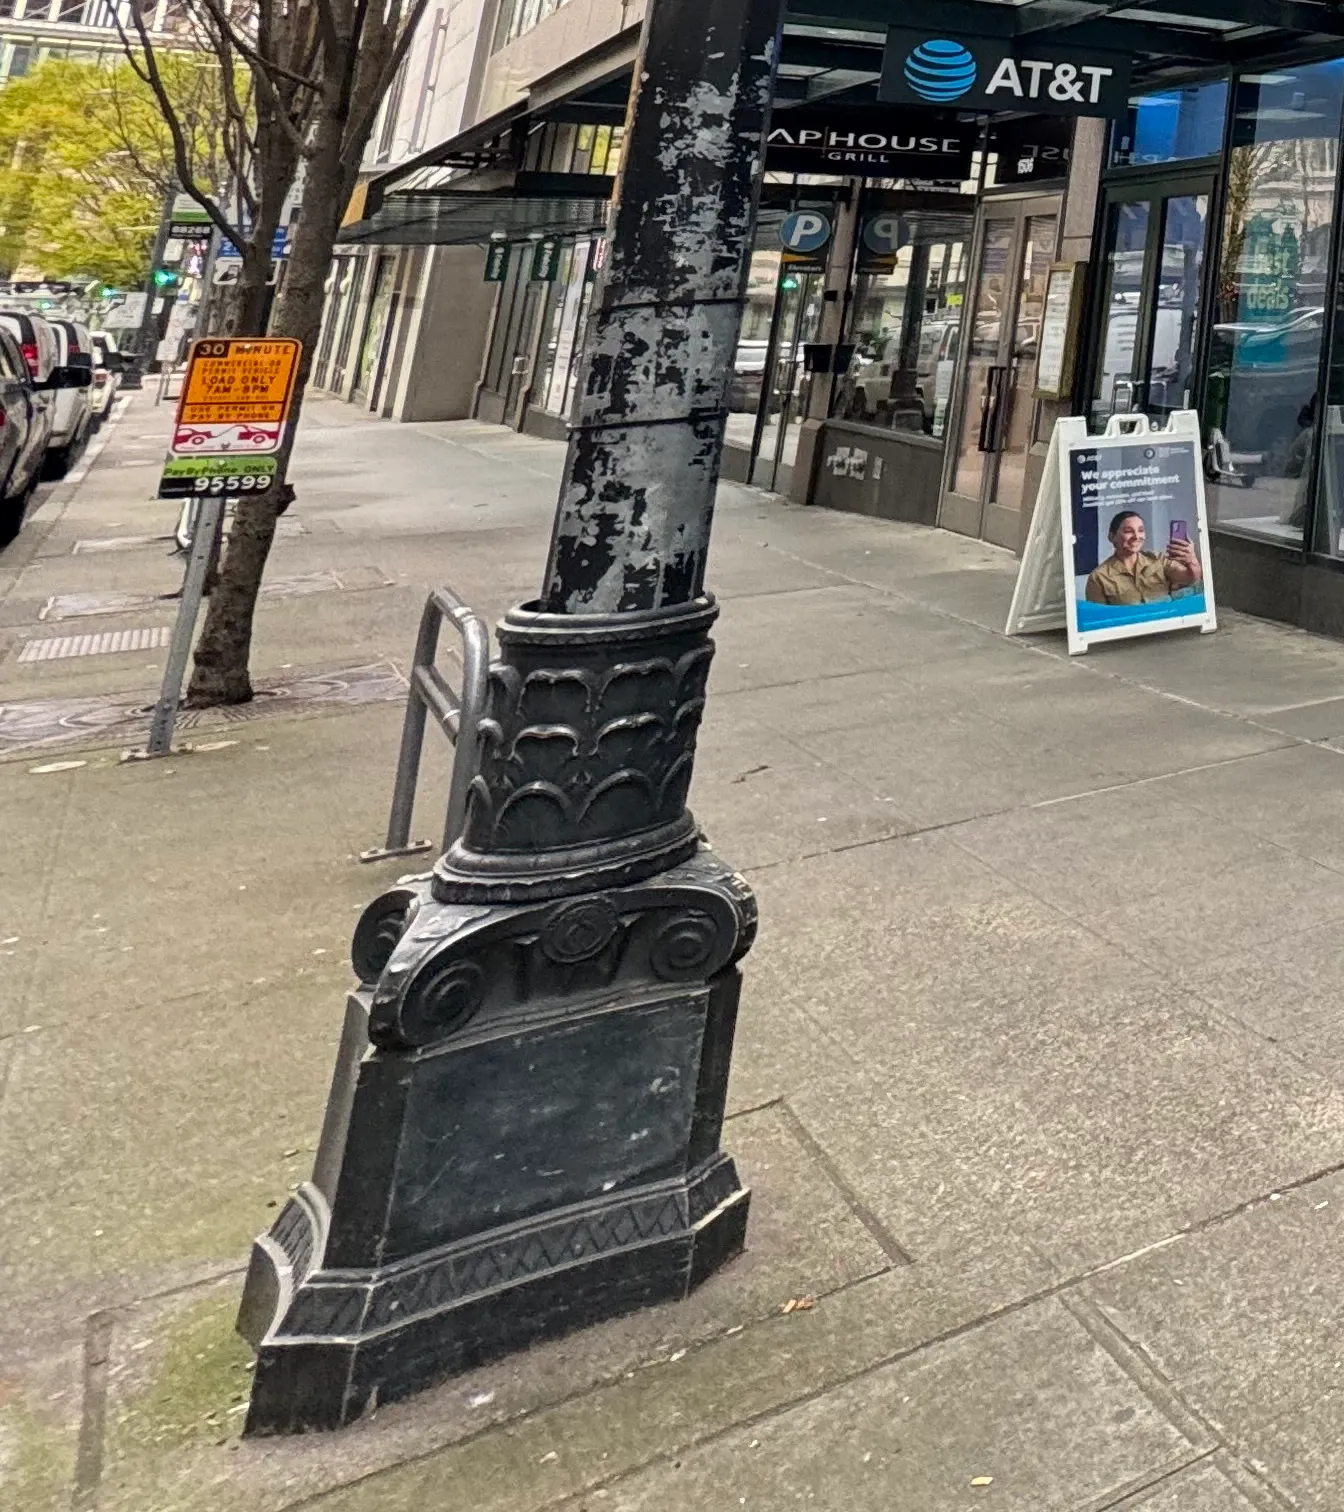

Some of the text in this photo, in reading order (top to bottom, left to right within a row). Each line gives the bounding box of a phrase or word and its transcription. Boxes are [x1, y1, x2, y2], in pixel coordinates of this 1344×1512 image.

[984, 58, 1113, 104] AT&T
[767, 128, 961, 153] APHOUSE
[827, 152, 889, 163] GRILL
[789, 214, 822, 247] P
[200, 343, 225, 355] 30
[201, 375, 276, 385] LOAD ONLY
[243, 465, 274, 474] ONLY
[1081, 465, 1160, 480] We appreciate
[194, 475, 271, 492] 95599
[1081, 474, 1180, 495] your commitment
